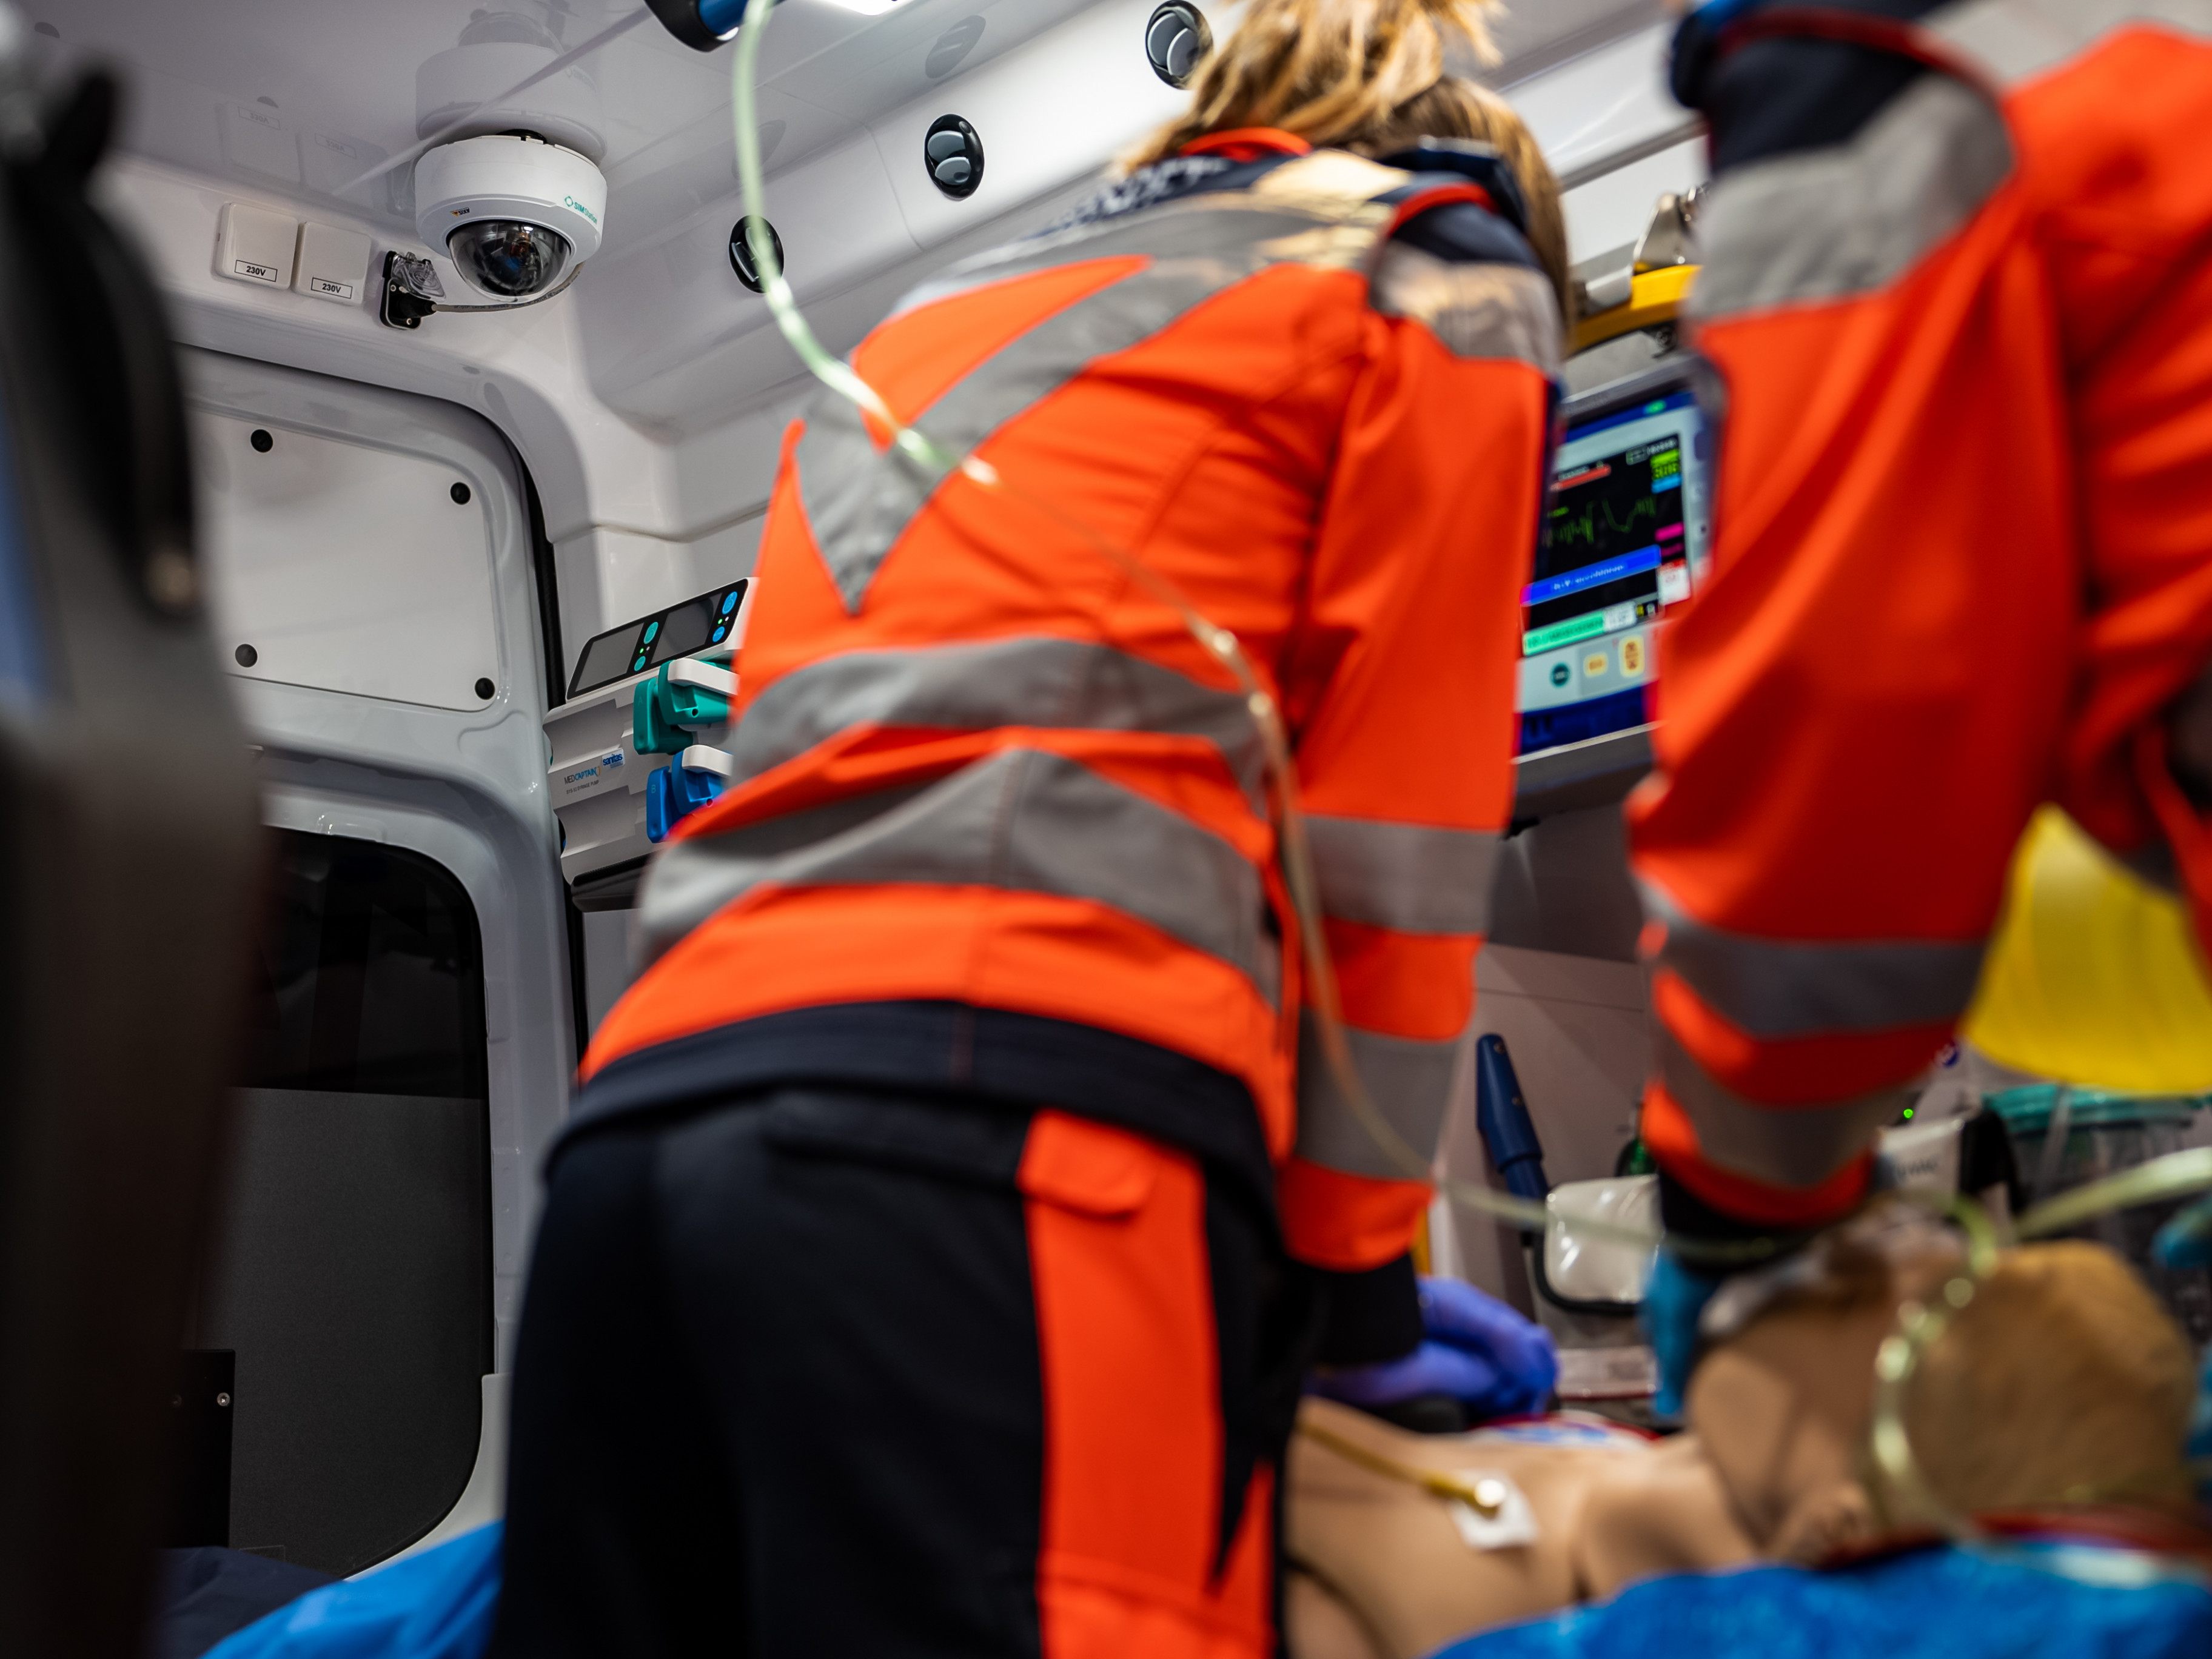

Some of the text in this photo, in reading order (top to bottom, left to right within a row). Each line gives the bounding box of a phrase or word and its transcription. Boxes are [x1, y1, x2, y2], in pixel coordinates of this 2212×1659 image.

[246, 266, 266, 276] 230V
[322, 283, 341, 293] 230V
[564, 766, 598, 785] MEDCAPTAIN
[651, 785, 656, 794] B
